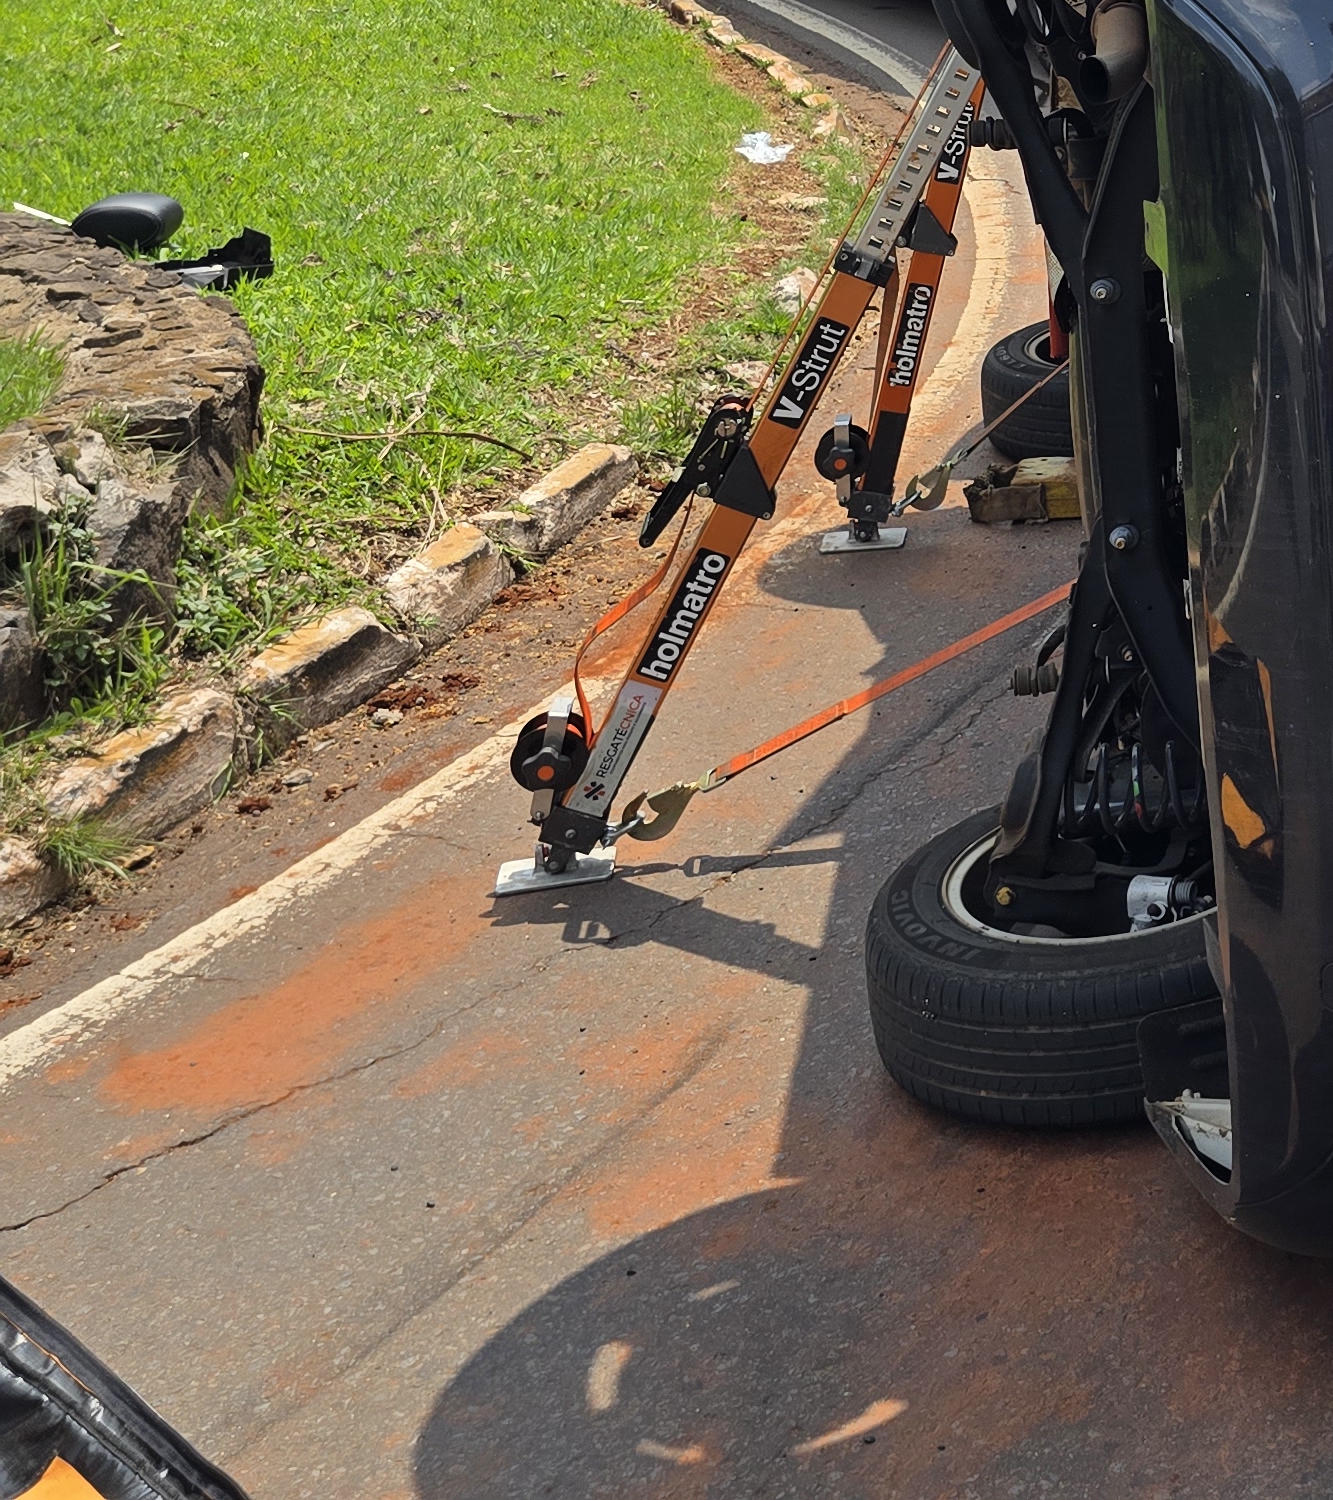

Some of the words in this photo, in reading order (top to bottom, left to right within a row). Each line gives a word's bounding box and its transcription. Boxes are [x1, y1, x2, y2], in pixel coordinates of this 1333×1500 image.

[772, 321, 848, 423] V-Strut
[889, 285, 932, 387] holmatro
[639, 552, 728, 683] holmatro
[595, 694, 646, 779] RESGATÉCNICA
[890, 888, 983, 962] INVOVIC
